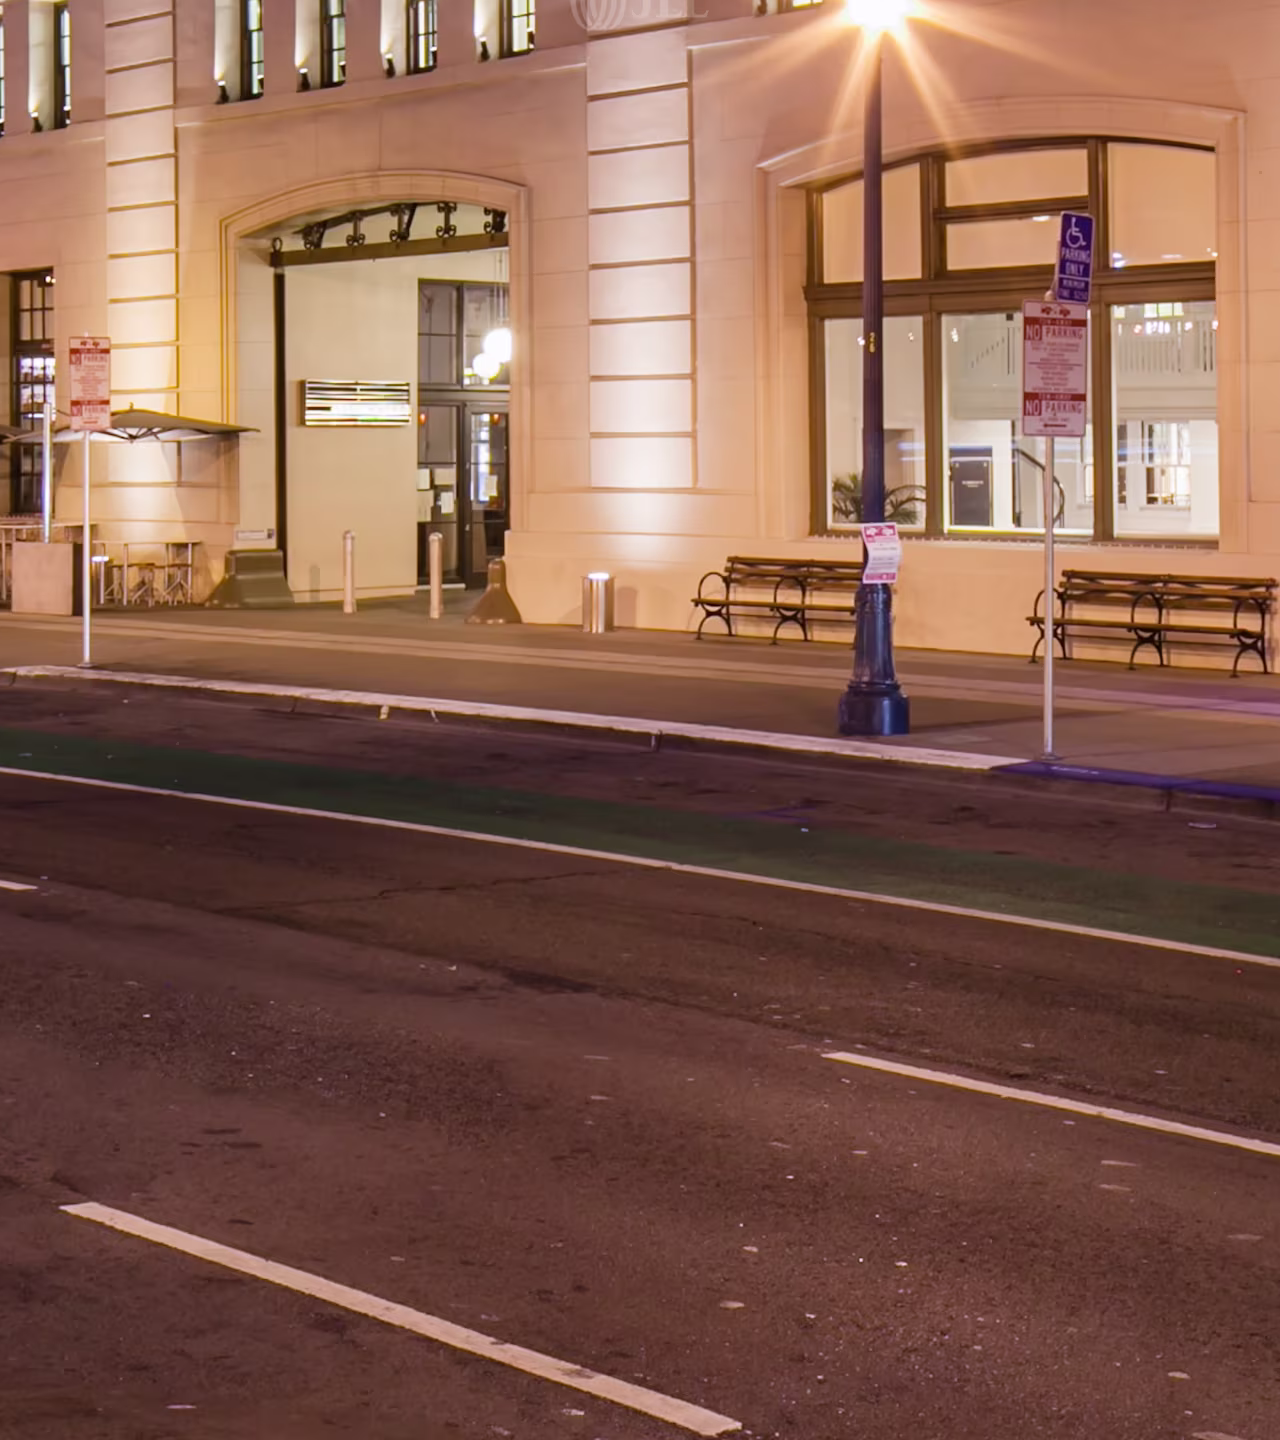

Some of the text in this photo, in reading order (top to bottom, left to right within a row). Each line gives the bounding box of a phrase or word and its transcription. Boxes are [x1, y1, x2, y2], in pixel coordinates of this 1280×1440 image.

[1061, 247, 1090, 264] PARKING
[1065, 261, 1085, 276] ONLY
[1026, 325, 1082, 340] NO PARKING
[1025, 400, 1082, 415] NO PARKING
